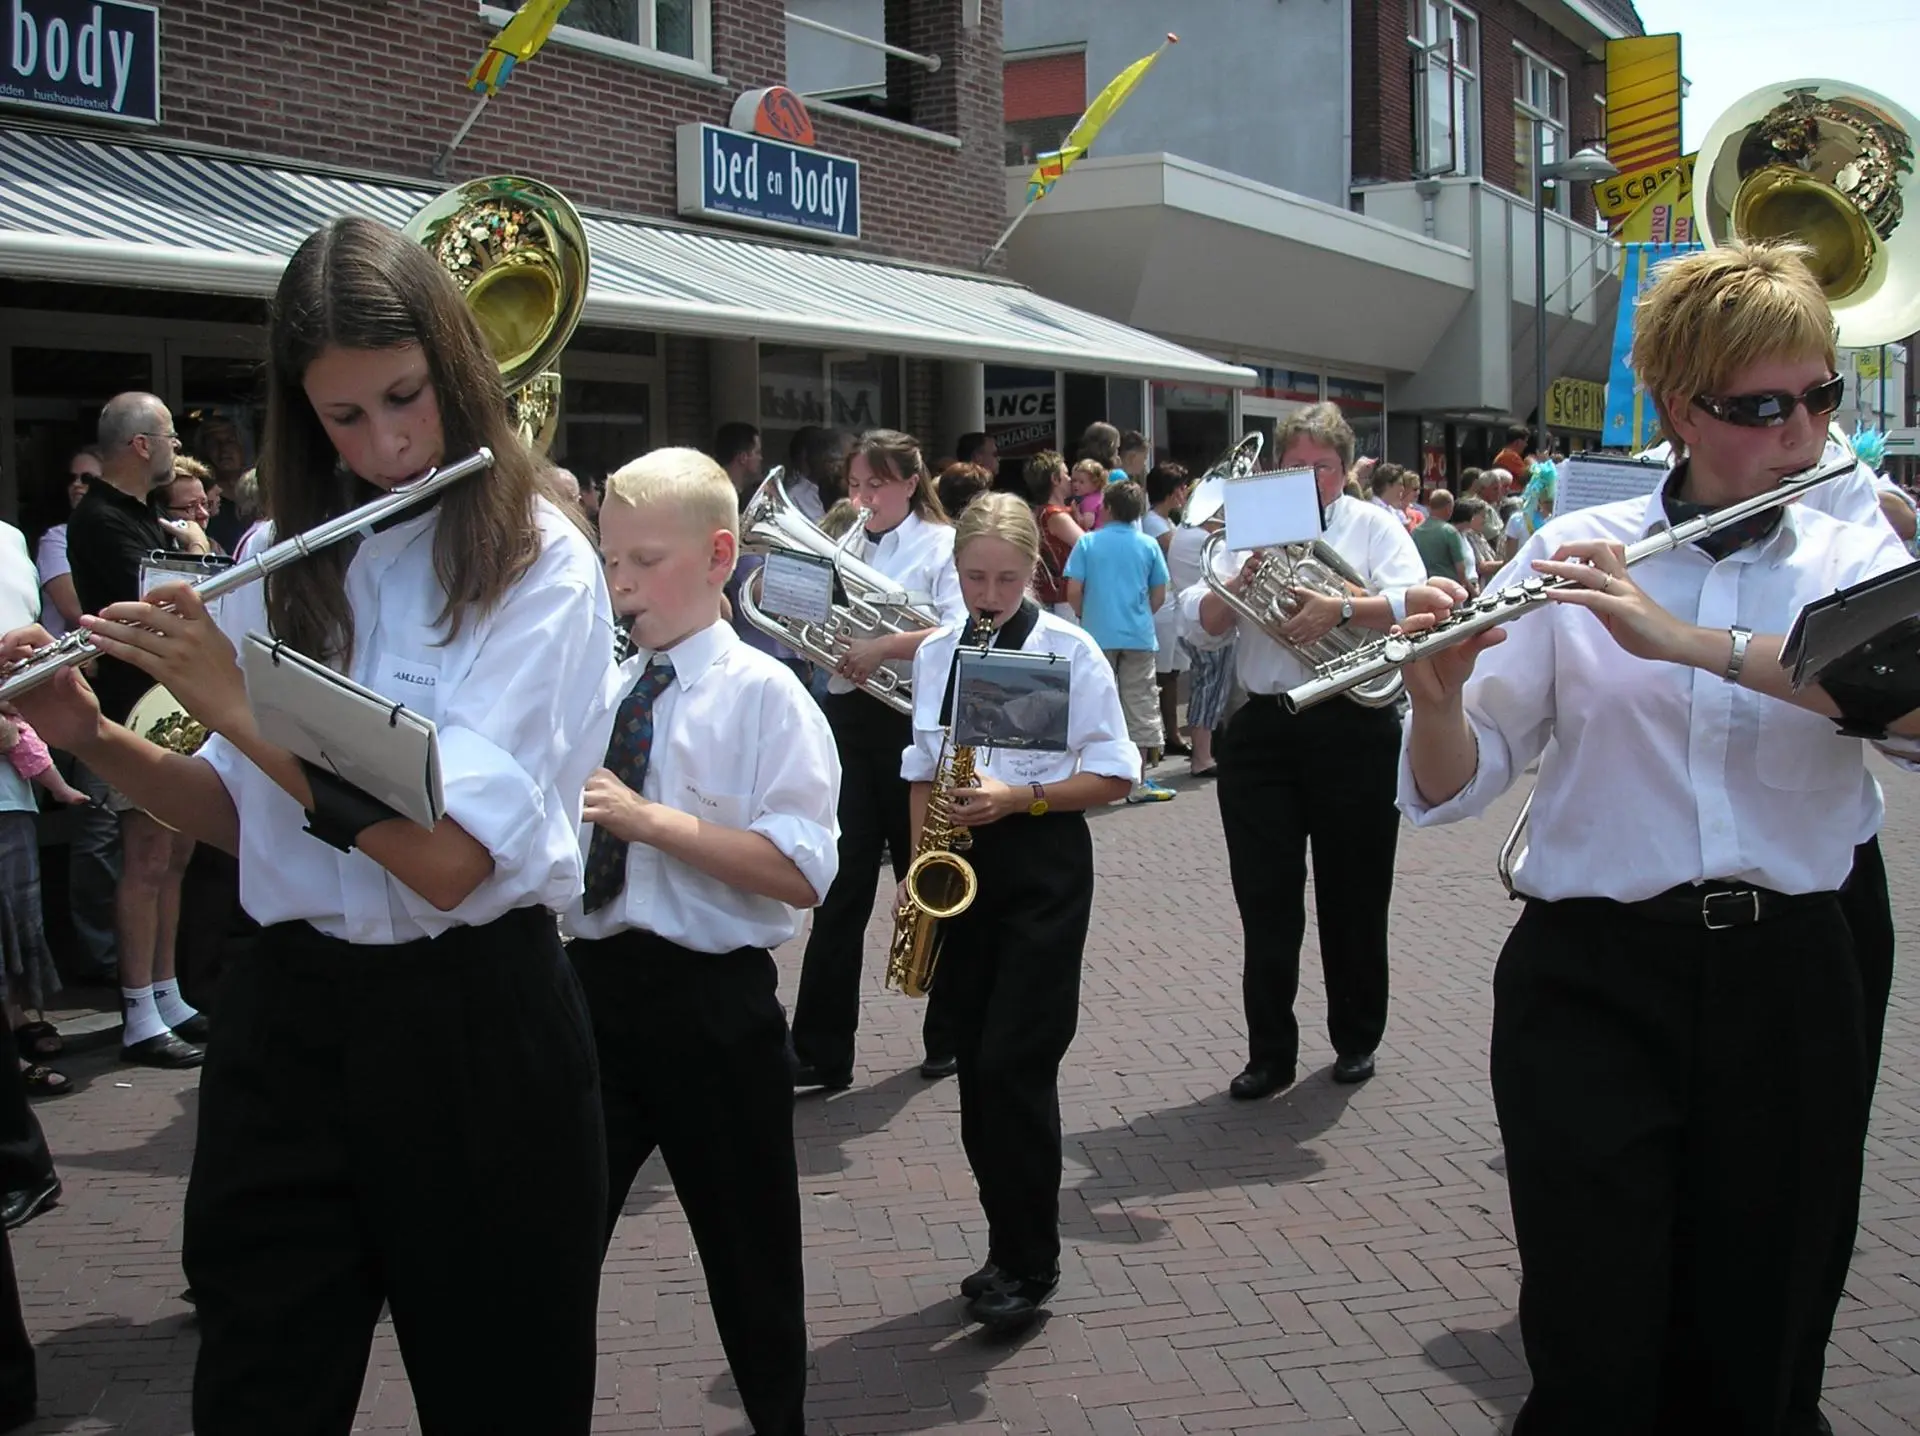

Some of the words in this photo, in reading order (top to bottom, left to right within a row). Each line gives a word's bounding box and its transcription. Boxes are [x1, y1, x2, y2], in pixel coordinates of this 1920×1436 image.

[12, 0, 134, 112] body
[713, 132, 758, 201] bed
[767, 171, 782, 195] en
[791, 151, 848, 232] body
